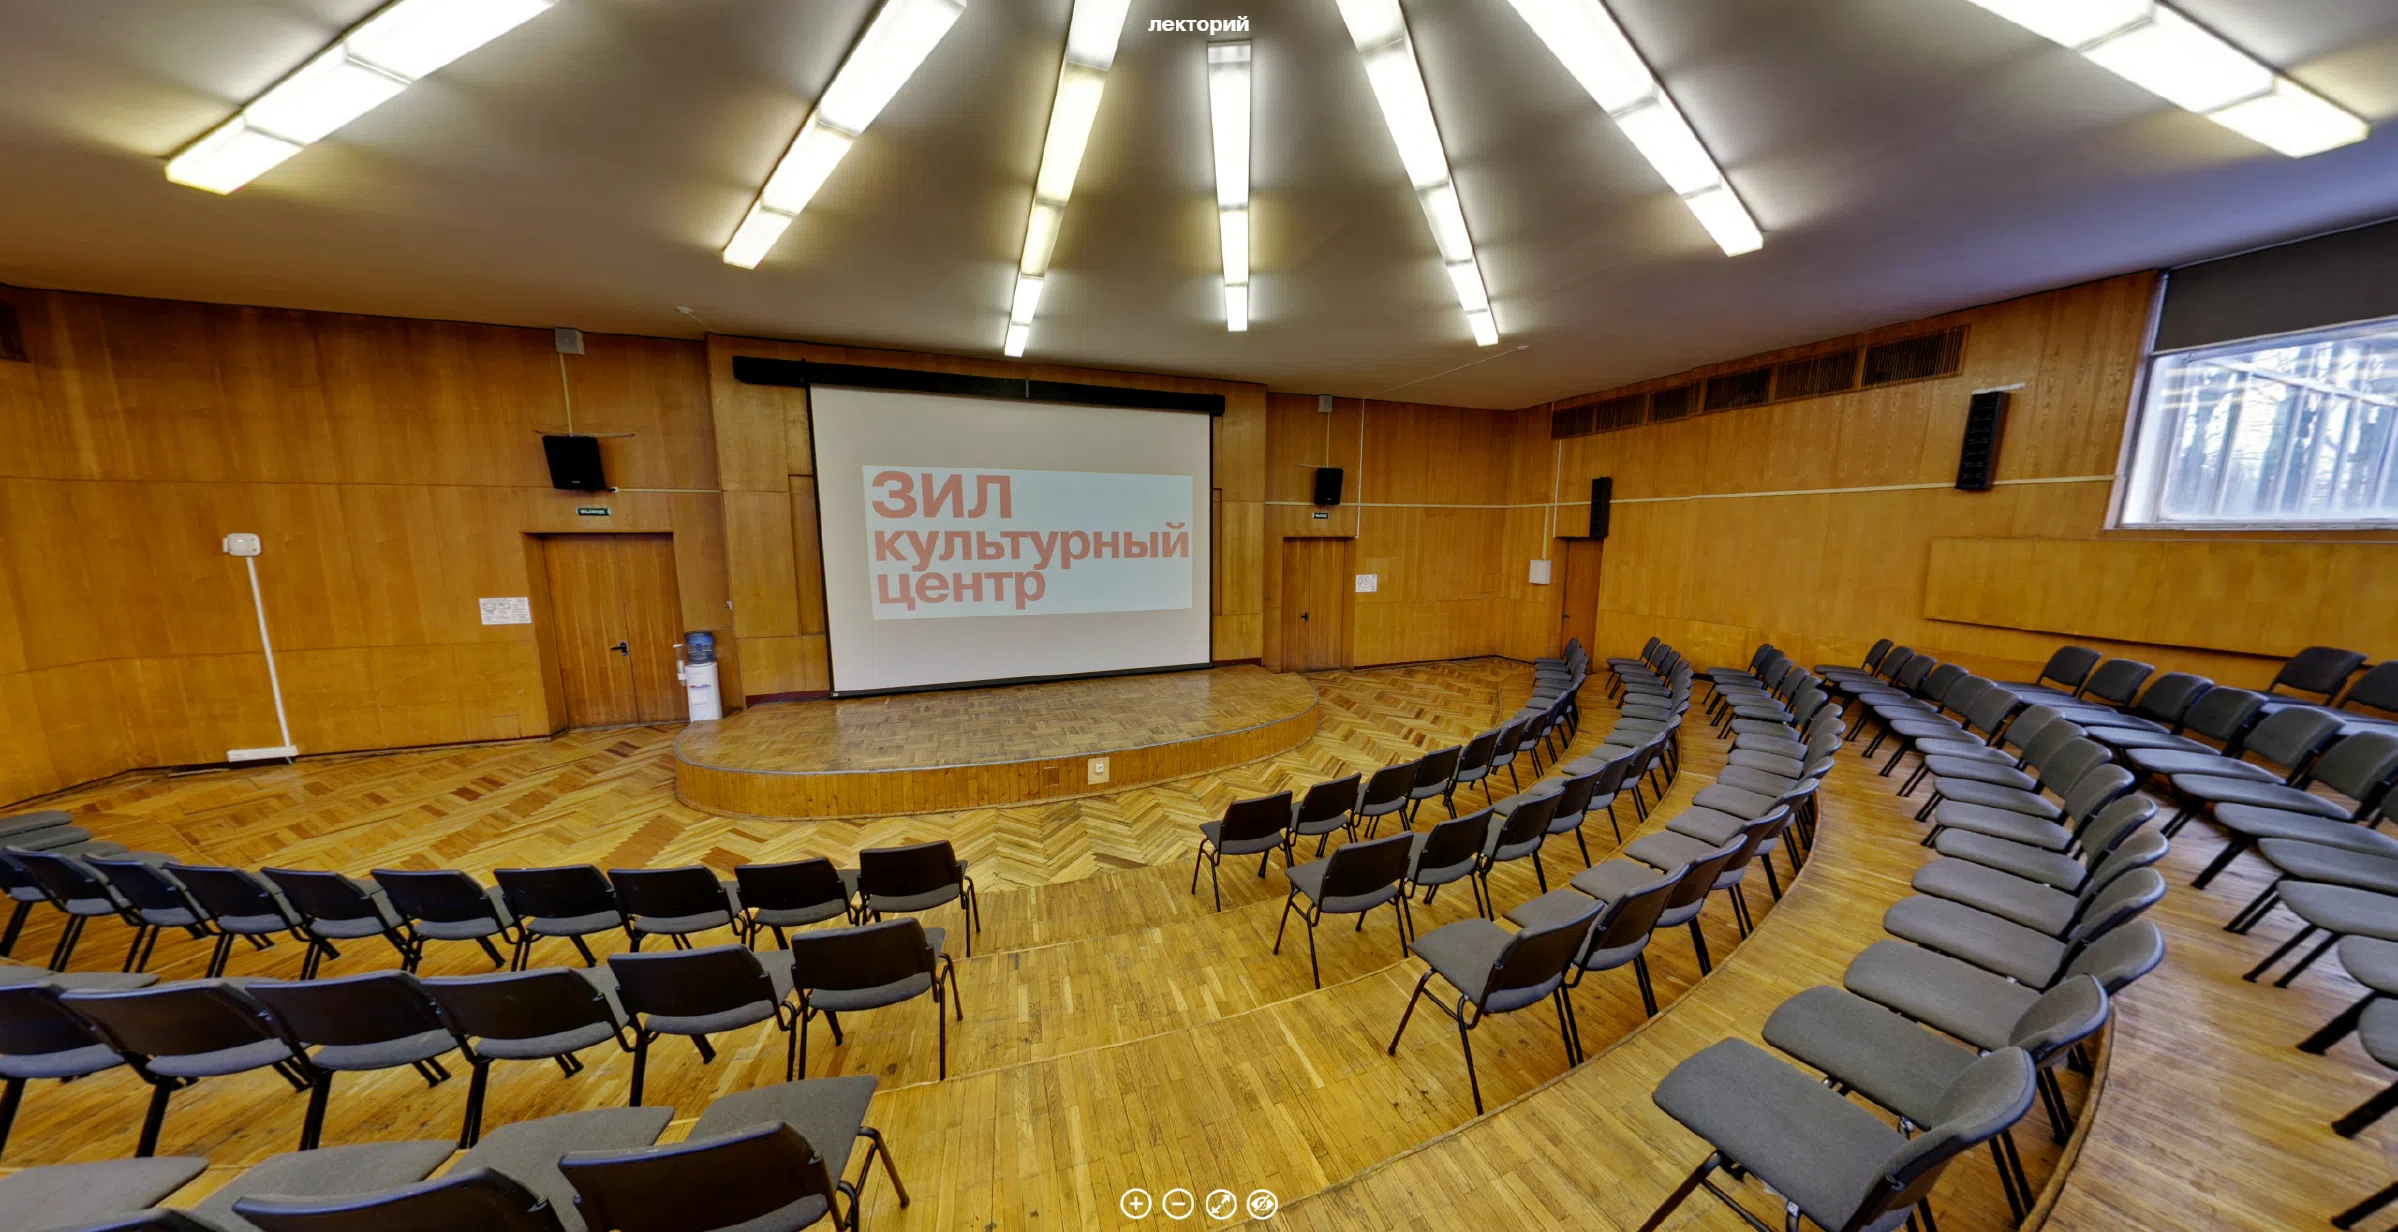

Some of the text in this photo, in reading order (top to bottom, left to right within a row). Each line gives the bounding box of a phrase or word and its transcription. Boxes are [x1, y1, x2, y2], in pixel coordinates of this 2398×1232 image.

[871, 470, 1013, 519] ЗИЛ
[874, 521, 1189, 572] культурный
[877, 571, 1046, 612] центр
